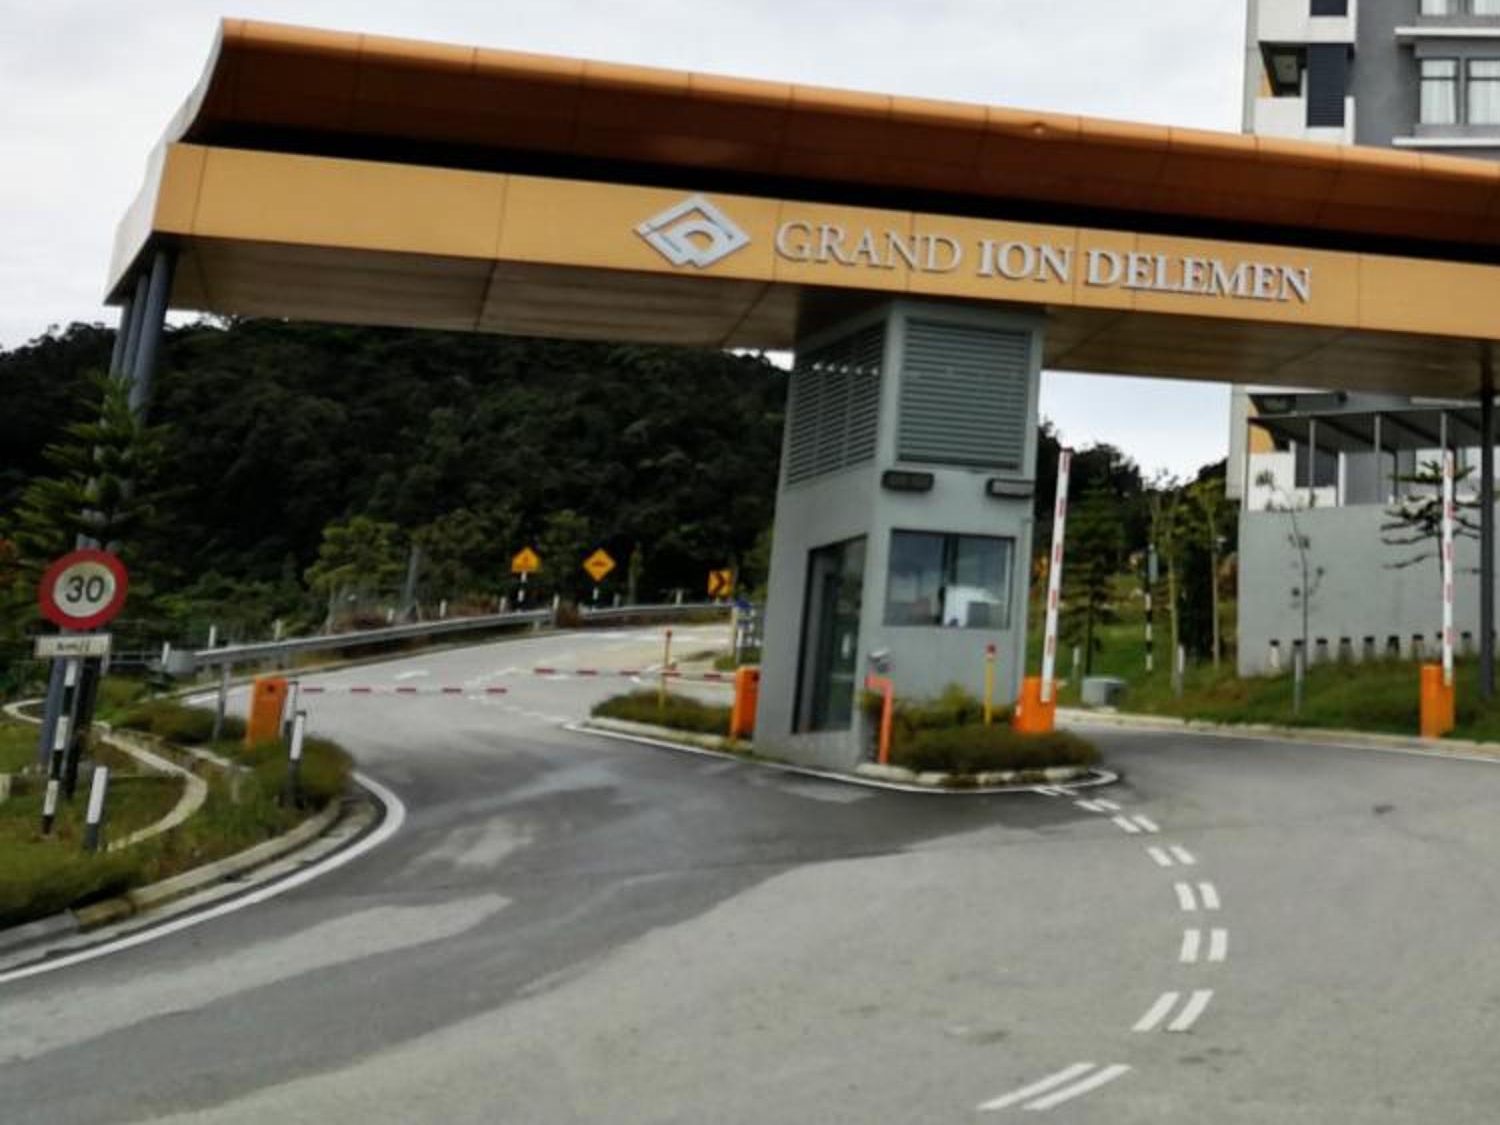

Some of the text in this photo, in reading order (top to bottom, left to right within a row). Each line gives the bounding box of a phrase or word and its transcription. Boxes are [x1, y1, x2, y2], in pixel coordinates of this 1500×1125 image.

[775, 220, 1313, 304] GRAND ION DELEMEN
[65, 575, 105, 603] 30
